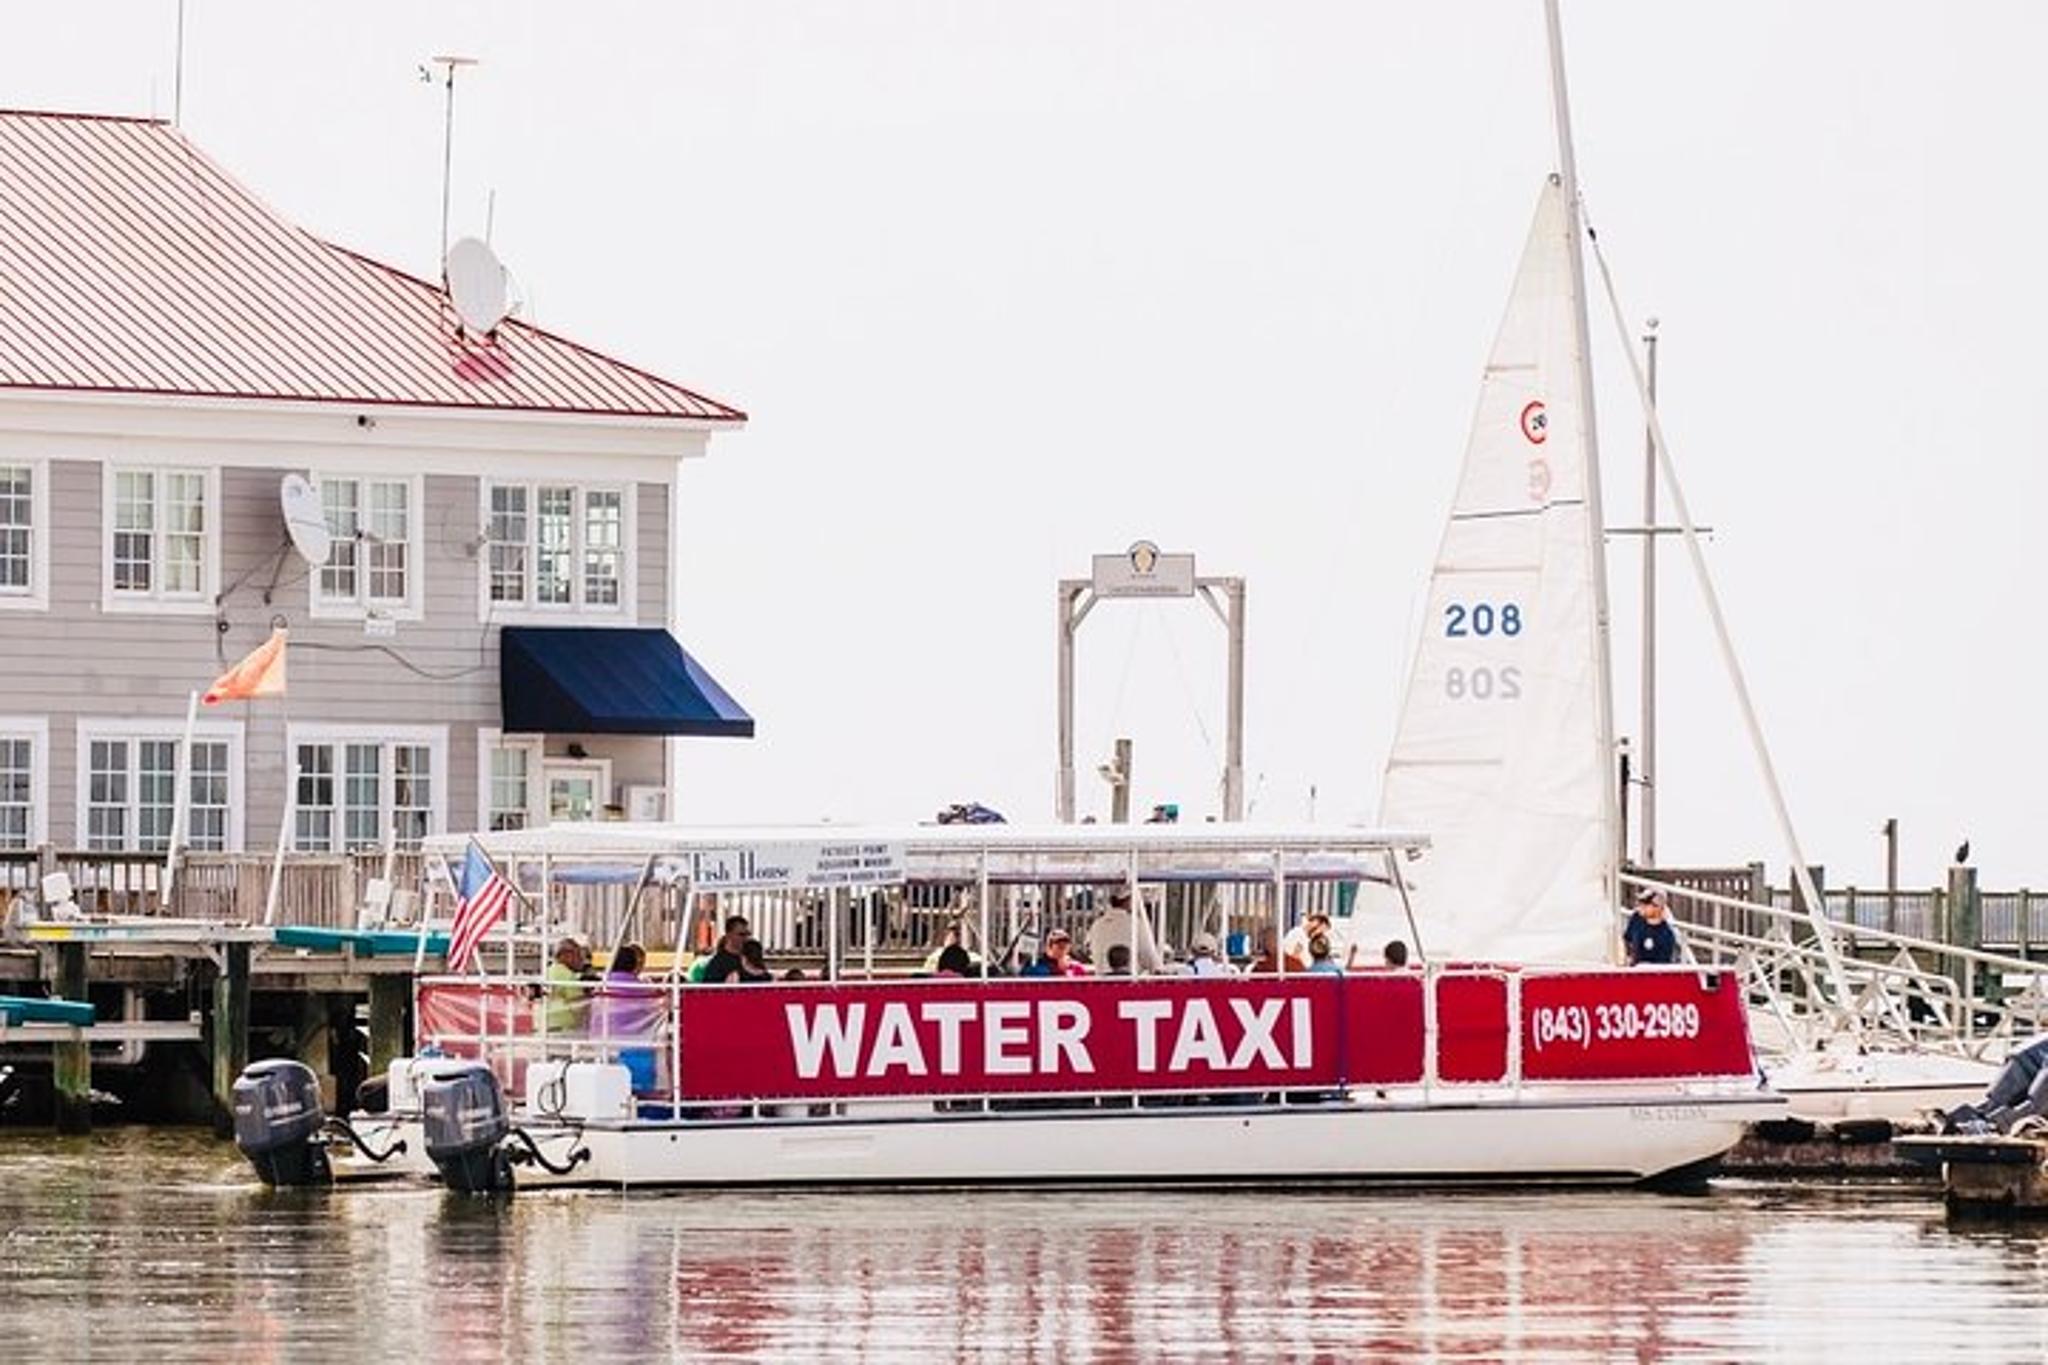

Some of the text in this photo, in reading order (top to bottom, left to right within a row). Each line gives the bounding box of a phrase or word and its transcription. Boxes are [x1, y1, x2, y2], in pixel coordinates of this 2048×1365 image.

[1444, 603, 1522, 637] 208
[693, 850, 791, 882] Fish House
[785, 997, 1313, 1078] WATER TAXI
[1532, 1003, 1699, 1050] (843) 330-2989
